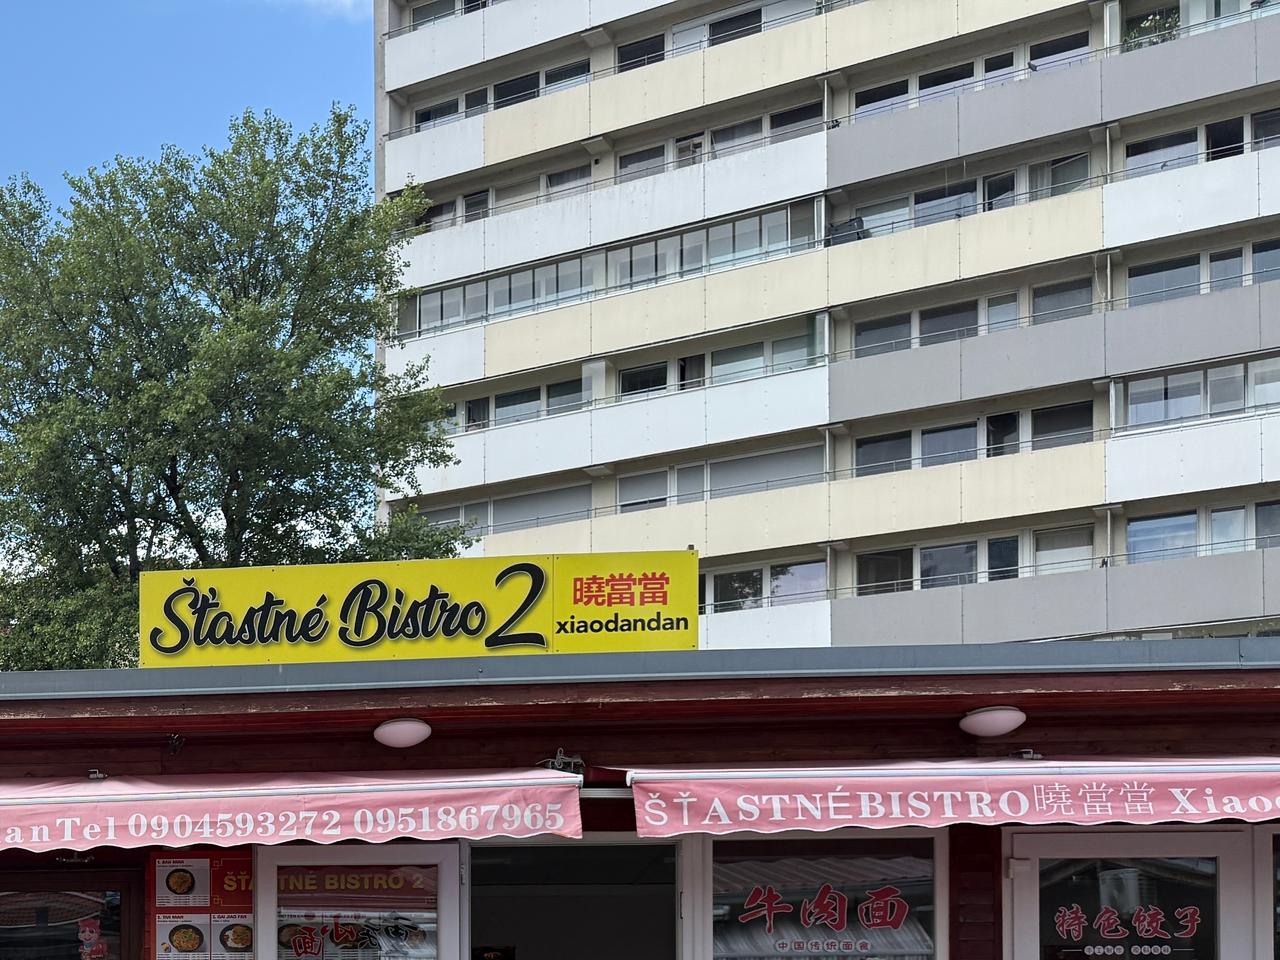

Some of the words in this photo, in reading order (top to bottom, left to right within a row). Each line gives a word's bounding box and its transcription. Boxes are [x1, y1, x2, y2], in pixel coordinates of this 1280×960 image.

[572, 572, 670, 607] 曉當當
[150, 576, 329, 653] Šťastné
[340, 579, 484, 648] Bistro
[484, 564, 548, 649] 2
[555, 611, 689, 634] xiaodandan
[1167, 788, 1280, 814] Xiao
[128, 809, 341, 839] 0904593272
[354, 803, 565, 834] 0951867965
[223, 870, 317, 891] ŠŤTNÉ
[324, 873, 404, 891] BISTRO
[412, 873, 424, 889] 2
[738, 883, 909, 934] 牛肉面
[1054, 903, 1201, 941] 特色饺子
